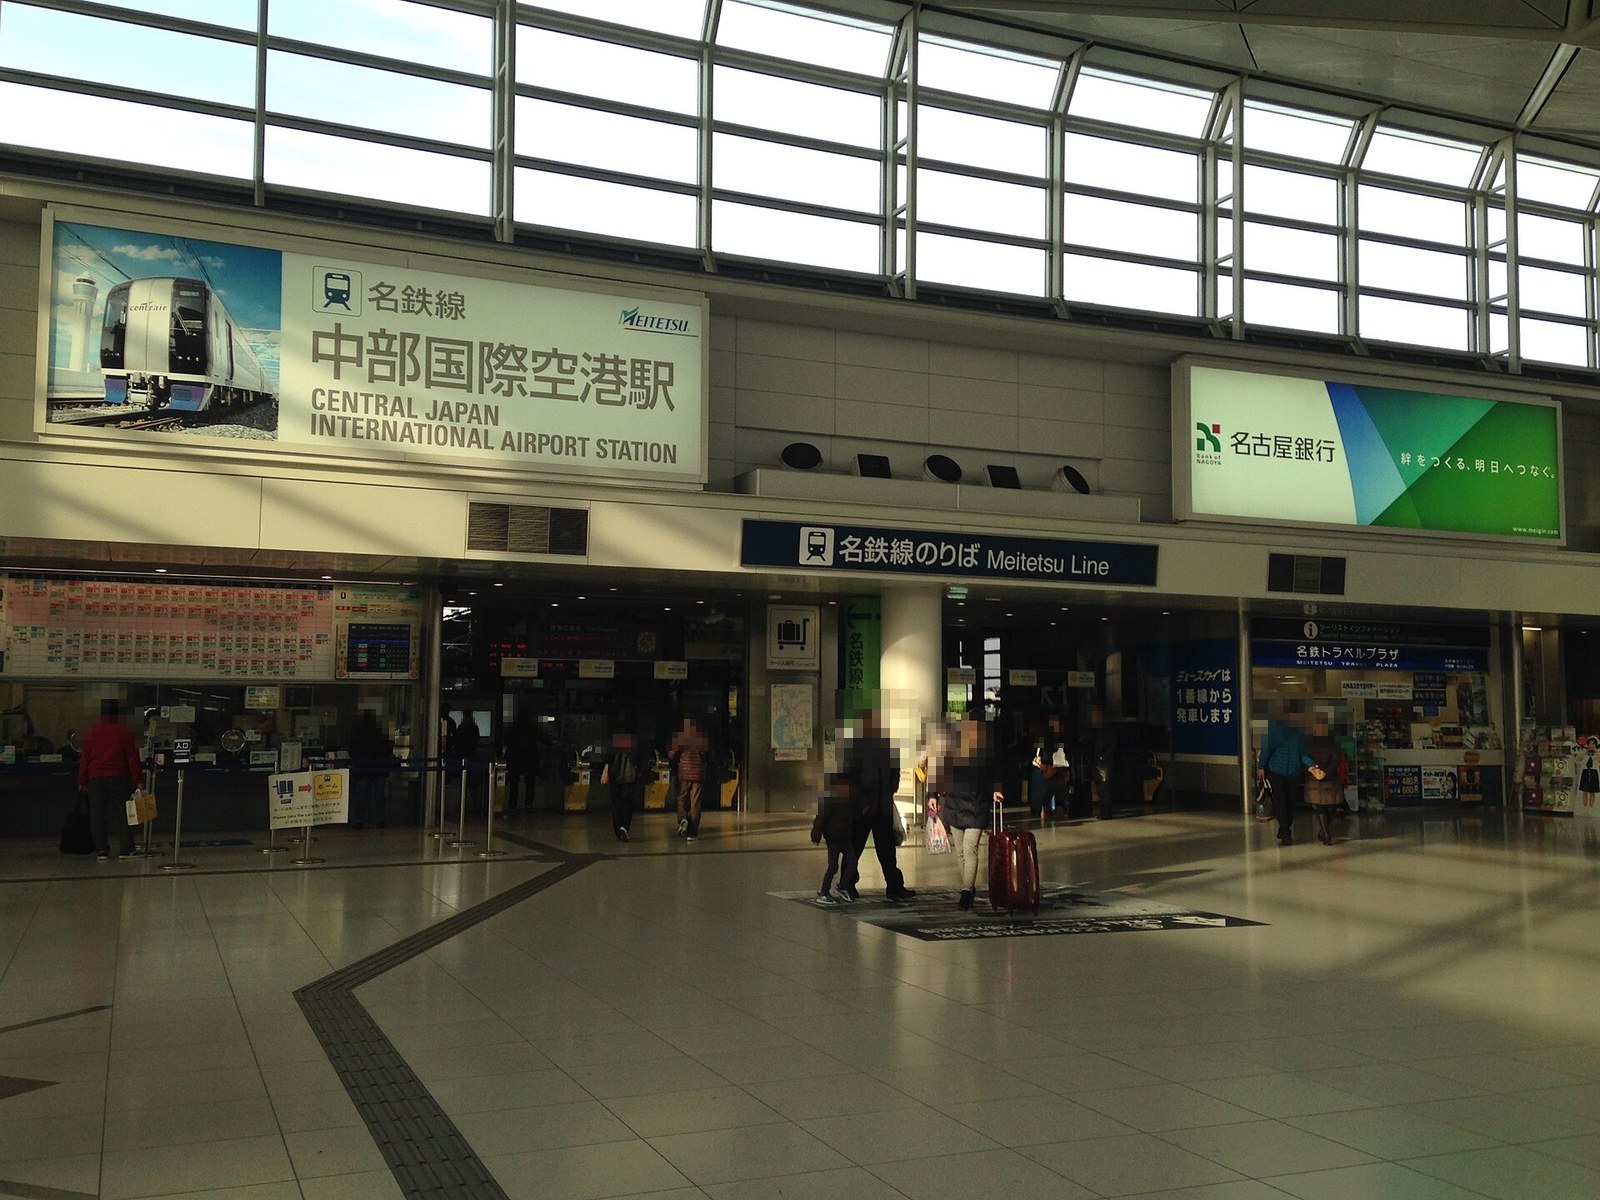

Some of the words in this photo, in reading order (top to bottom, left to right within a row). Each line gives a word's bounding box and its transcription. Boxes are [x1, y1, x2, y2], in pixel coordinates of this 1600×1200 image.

[368, 281, 466, 321] 名鉄線
[619, 306, 688, 332] MEITETSU
[311, 322, 675, 412] 中部国際空港駅
[311, 387, 418, 419] CENTRAL
[425, 400, 499, 427] JAPAN
[310, 413, 495, 450] INTERNATIONAL
[500, 430, 590, 457] AIRPORT
[595, 438, 677, 464] STATION
[1230, 431, 1335, 463] 名古屋銀行
[1400, 452, 1555, 479] 絆をつくる、明日へつなぐ。
[839, 534, 981, 568] 名鉄線のりば
[987, 549, 1064, 574] Meitetsu
[1071, 554, 1109, 576] Line
[848, 631, 864, 690] 名鉄線
[1296, 645, 1400, 661] 名鉄トラベルプラザ
[1296, 659, 1333, 667] MEITETSU
[1176, 687, 1232, 704] 1番線から
[1176, 707, 1233, 724] 発車します
[175, 742, 189, 750] 入口
